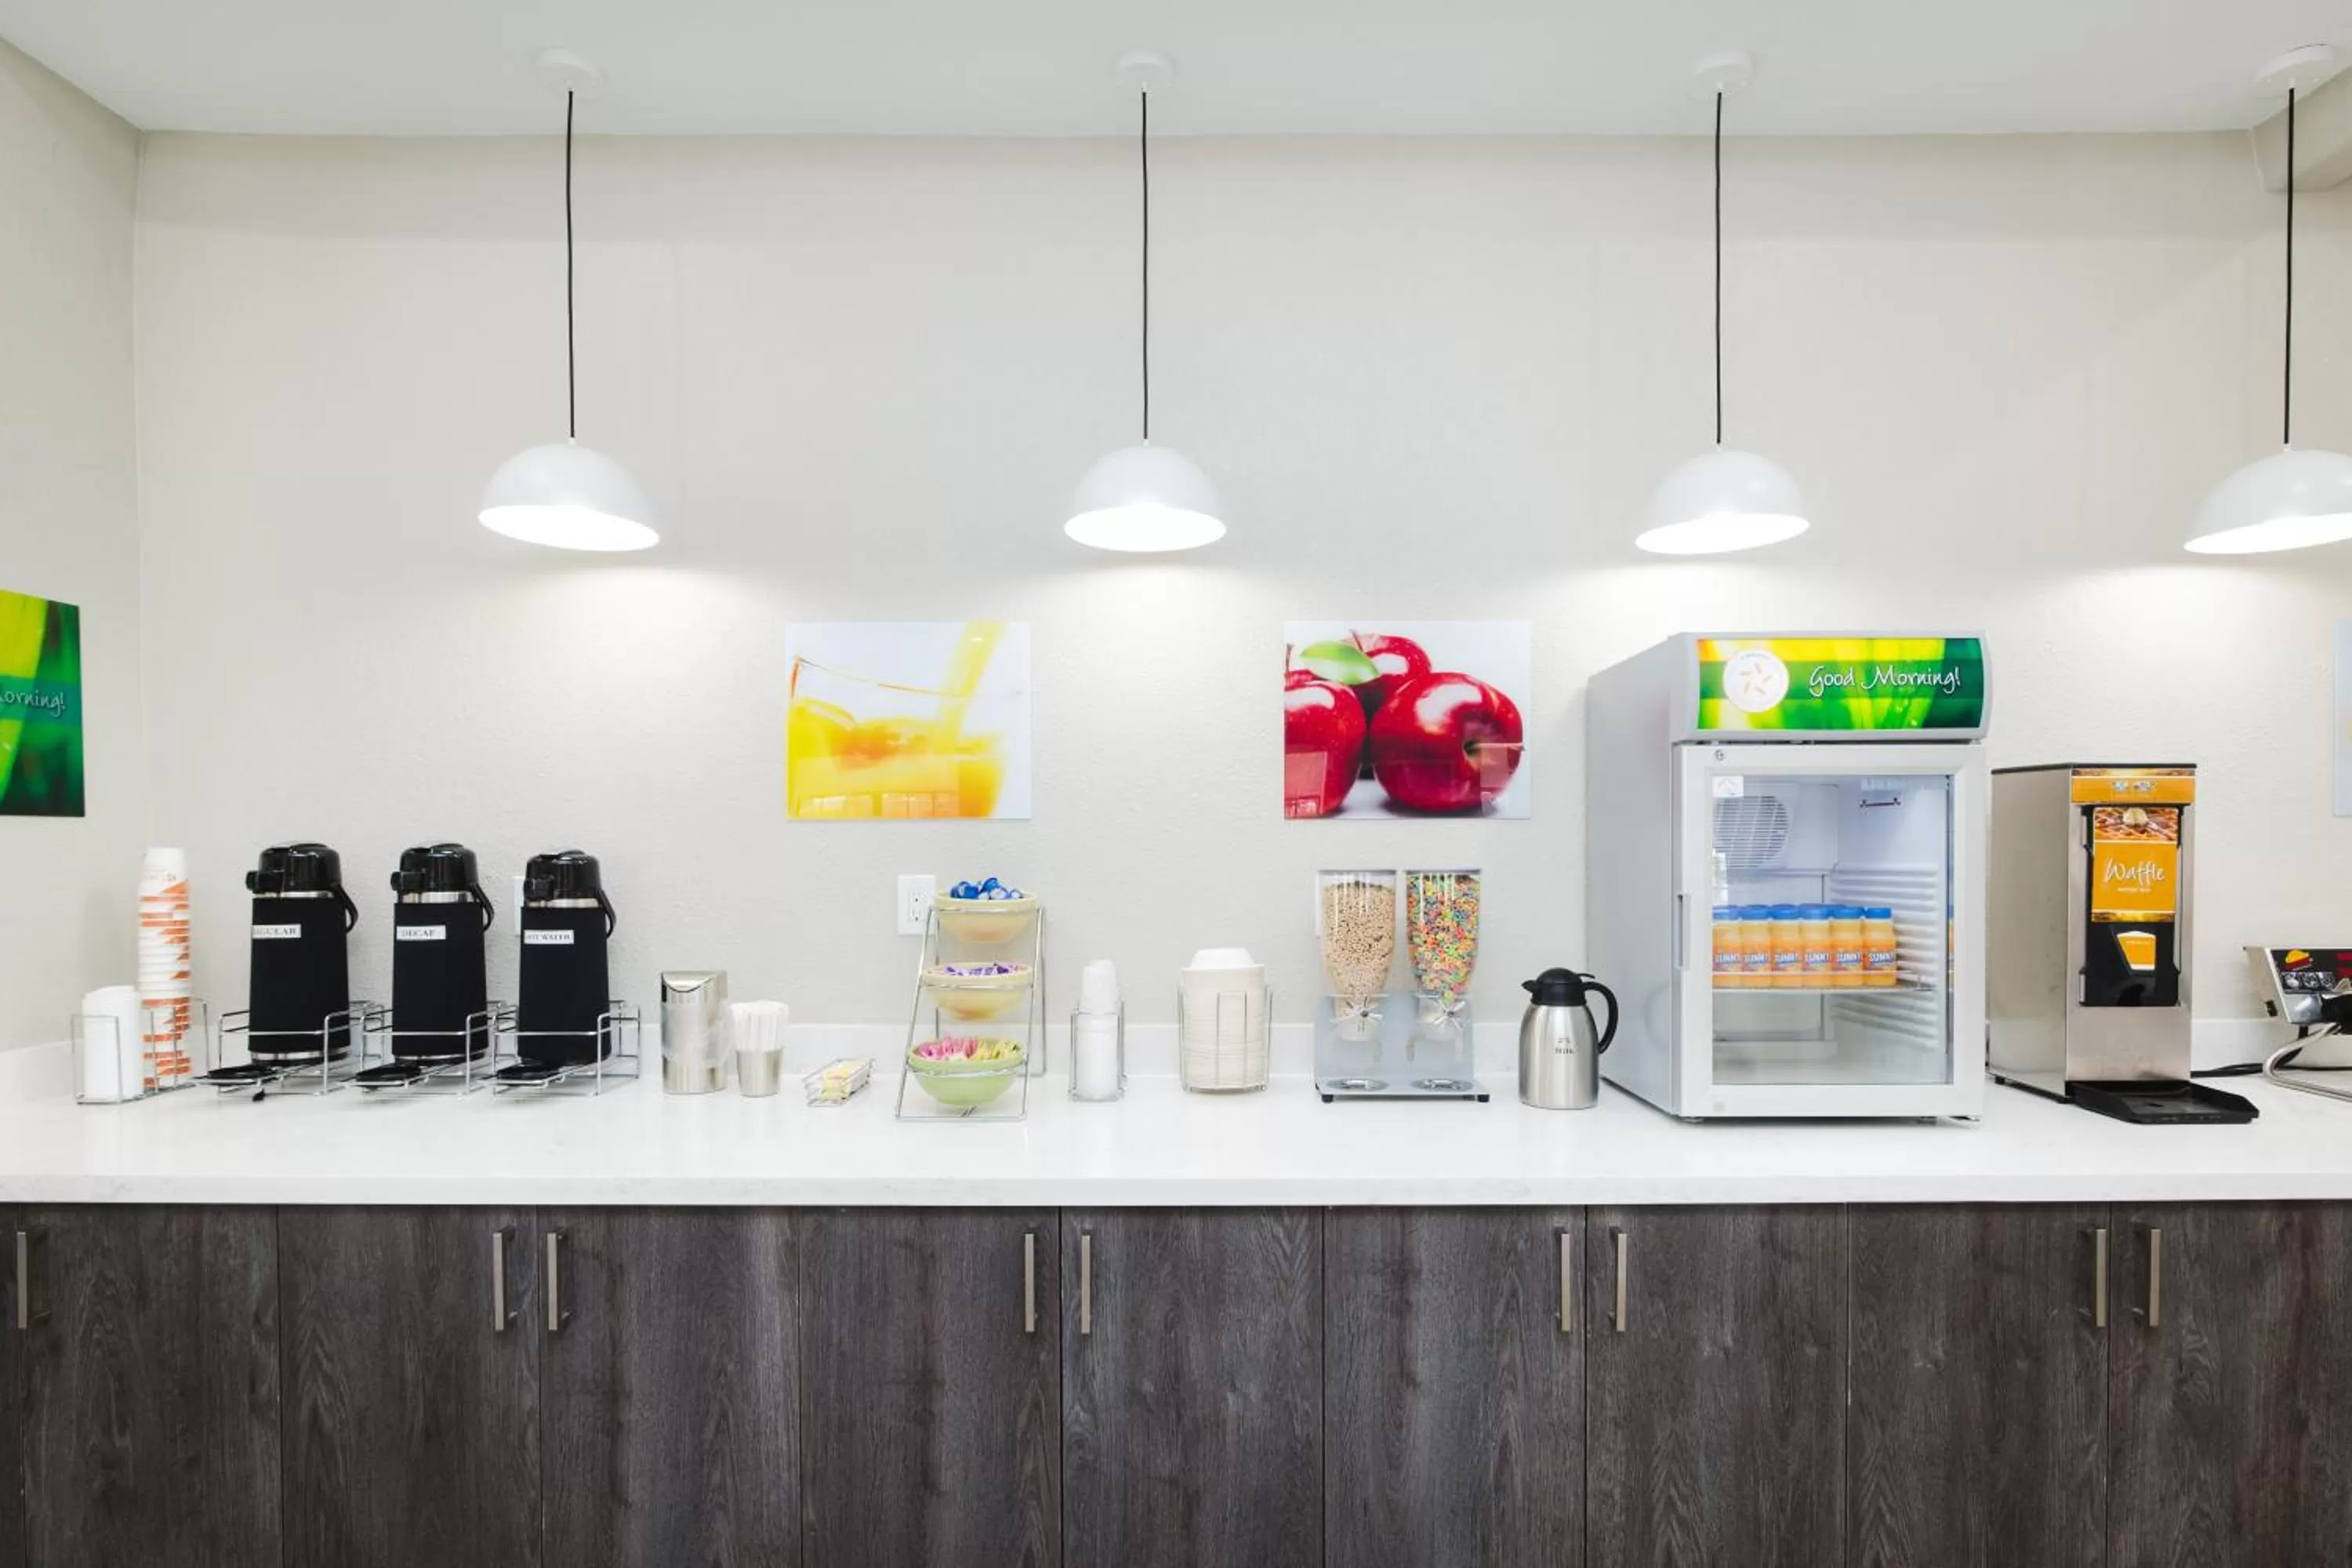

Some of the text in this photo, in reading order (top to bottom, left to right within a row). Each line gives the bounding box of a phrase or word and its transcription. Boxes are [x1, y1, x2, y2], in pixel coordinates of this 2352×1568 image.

[1809, 665, 1961, 697] Good Morning!
[2103, 858, 2165, 887] Waffle
